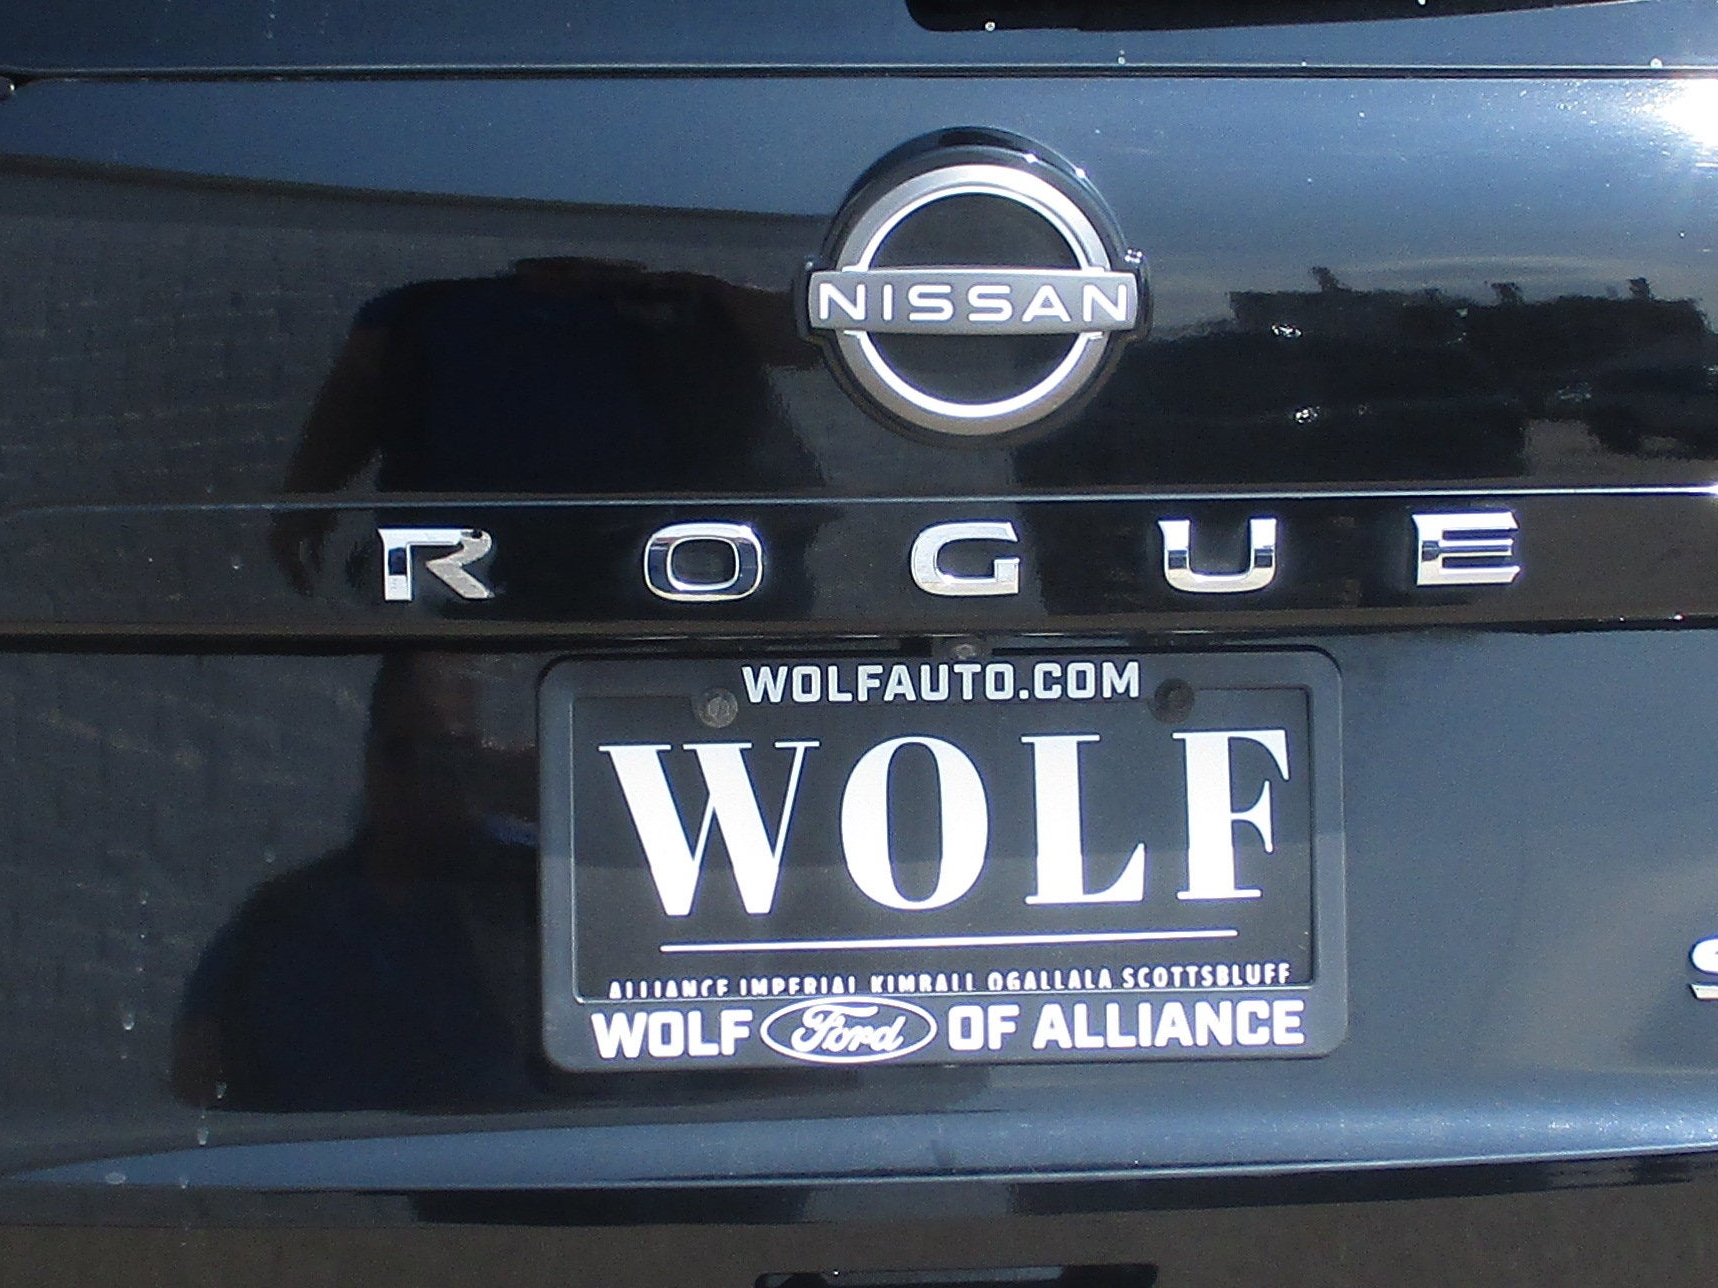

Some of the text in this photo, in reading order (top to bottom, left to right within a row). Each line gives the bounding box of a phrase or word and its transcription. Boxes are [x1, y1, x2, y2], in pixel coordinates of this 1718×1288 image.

[819, 282, 1128, 322] NISSAN
[377, 511, 1521, 604] ROGUE
[742, 660, 1141, 706] WOLFAUTO.COM
[597, 728, 1292, 918] WOLF
[988, 967, 1114, 991] OGALLALA
[1121, 961, 1292, 988] SCOTTSBLUFF
[591, 997, 1306, 1059] WOLF Ford OF ALLIANCE
